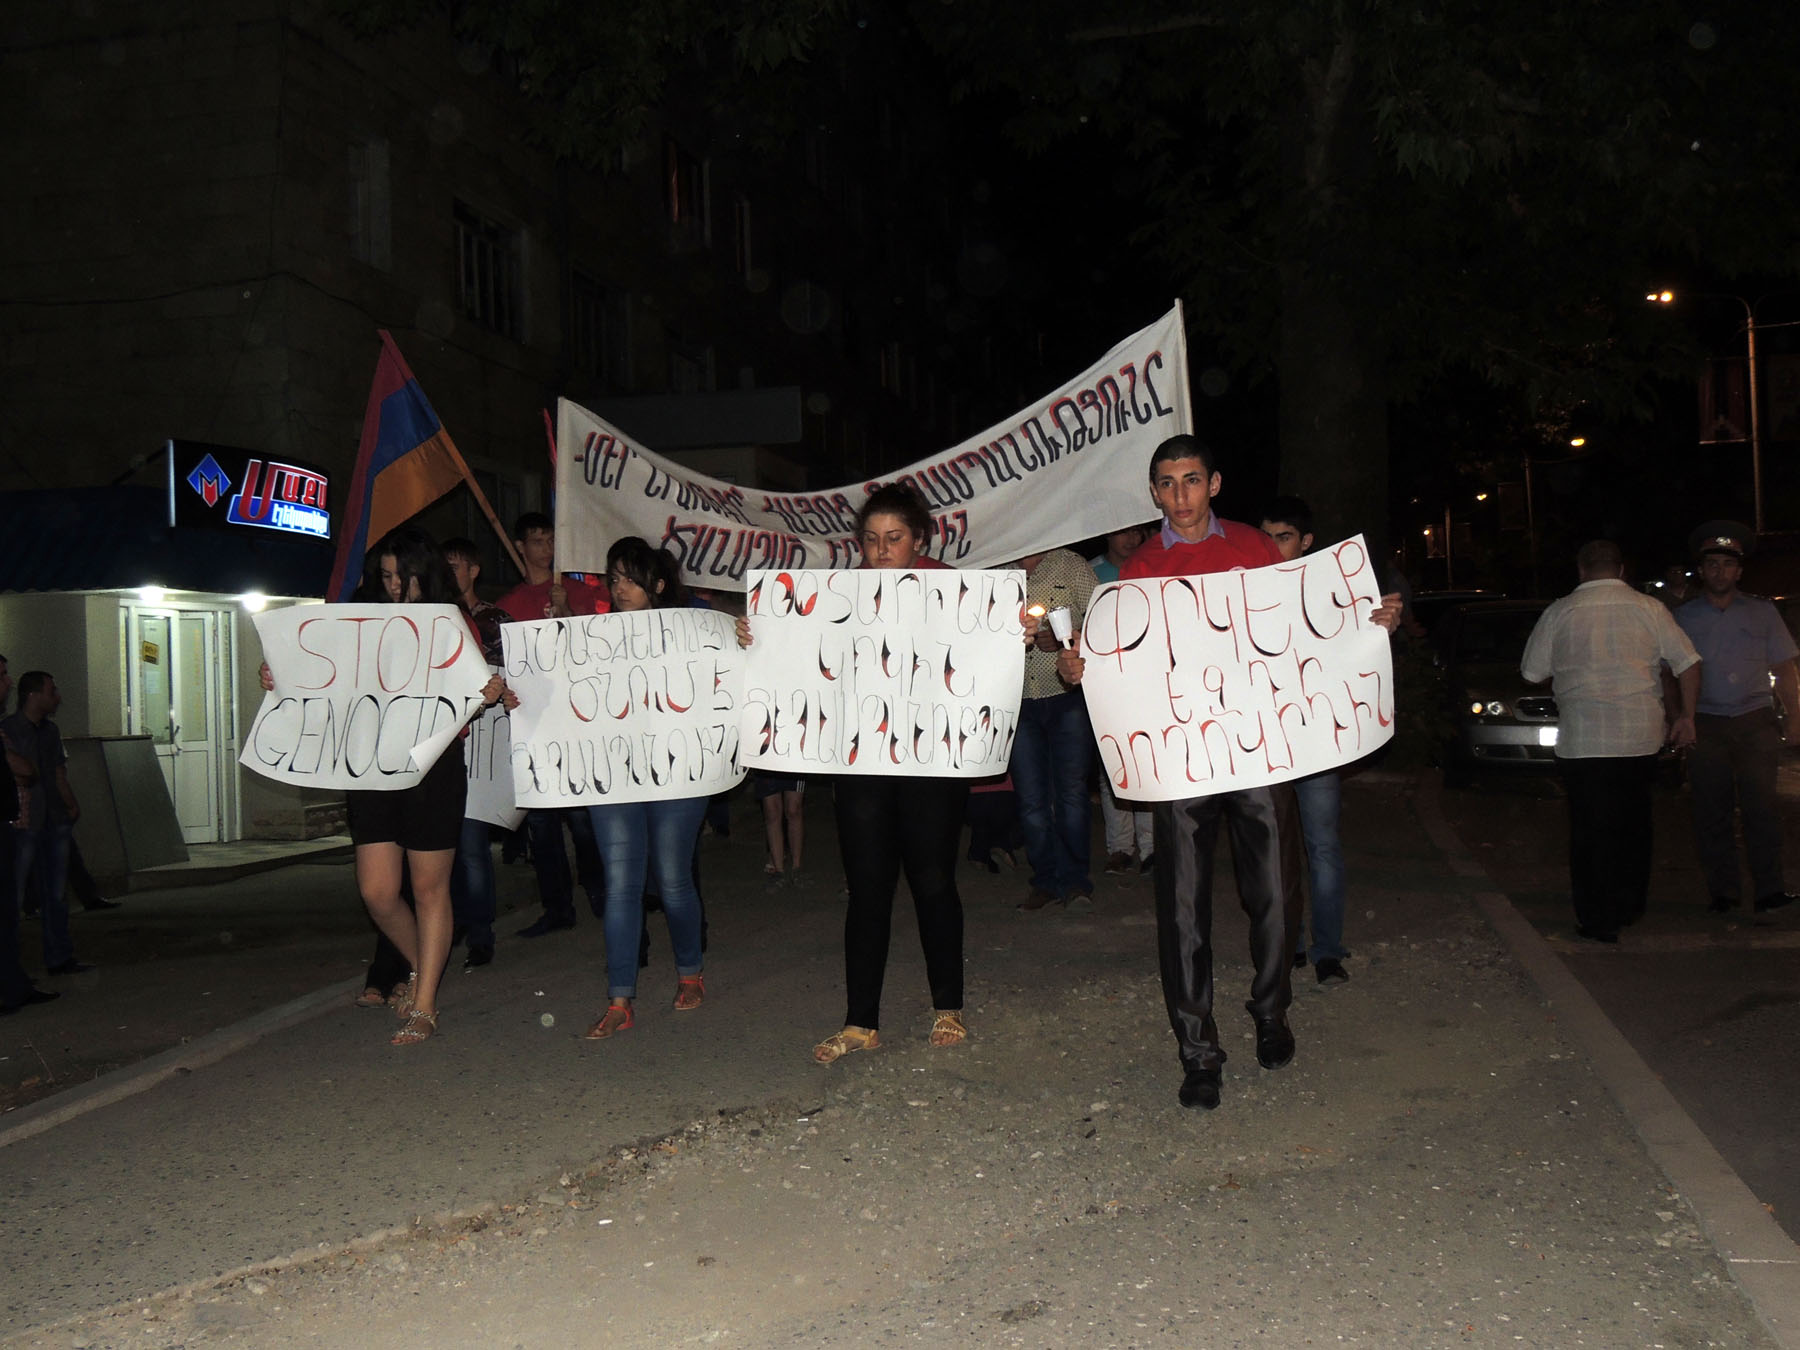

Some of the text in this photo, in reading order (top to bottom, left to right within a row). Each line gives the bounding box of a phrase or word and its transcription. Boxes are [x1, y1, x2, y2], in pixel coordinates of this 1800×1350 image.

[748, 570, 818, 618] 100
[827, 570, 944, 626] ՏԱՐԻ
[1084, 540, 1374, 673] ՓՐԿԵՆՔ
[295, 615, 464, 694] STOP
[818, 633, 976, 698] ԿՐԿԻՆ
[1100, 671, 1395, 790] ԺՈՂՈՎՐԴԻՆ
